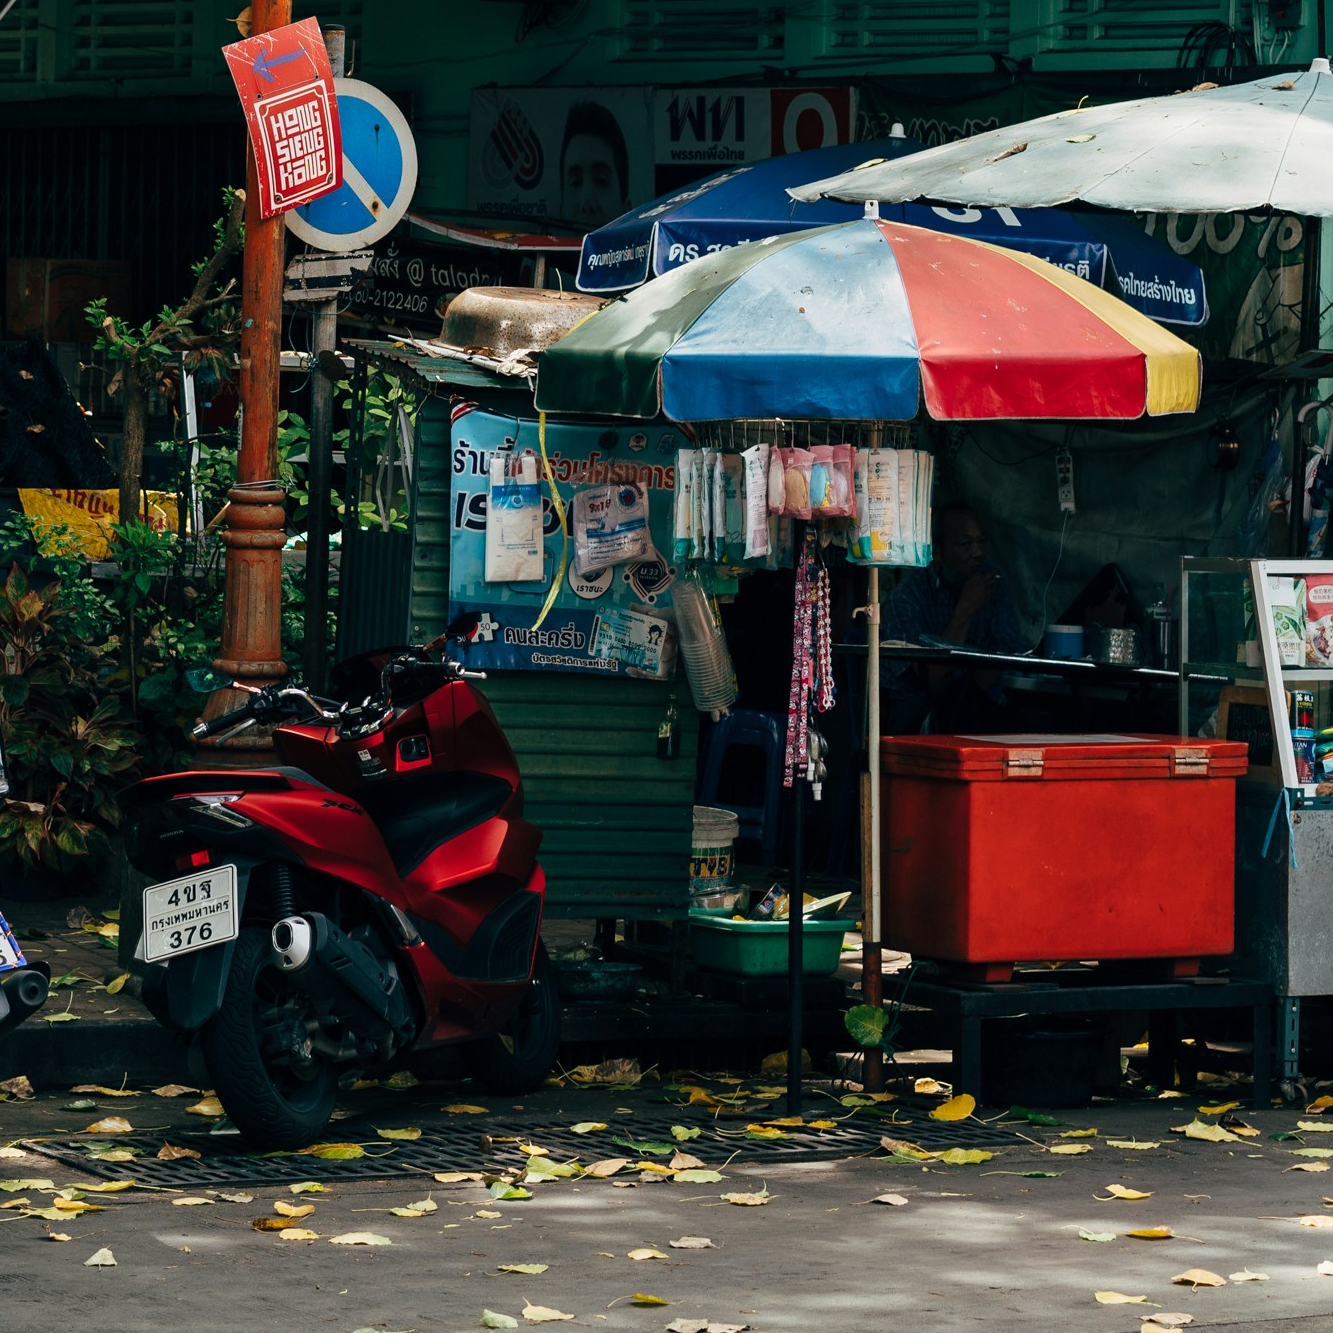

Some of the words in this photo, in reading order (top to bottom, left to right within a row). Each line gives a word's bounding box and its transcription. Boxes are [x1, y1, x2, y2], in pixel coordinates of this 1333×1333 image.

[269, 99, 322, 141] HONG
[275, 126, 325, 164] SIENG
[671, 144, 745, 161] พรรคเพื่อไทย
[504, 622, 586, 650] คนละครึ่ง
[151, 900, 229, 932] กรุงเทพมหานคร
[170, 922, 212, 949] 376
